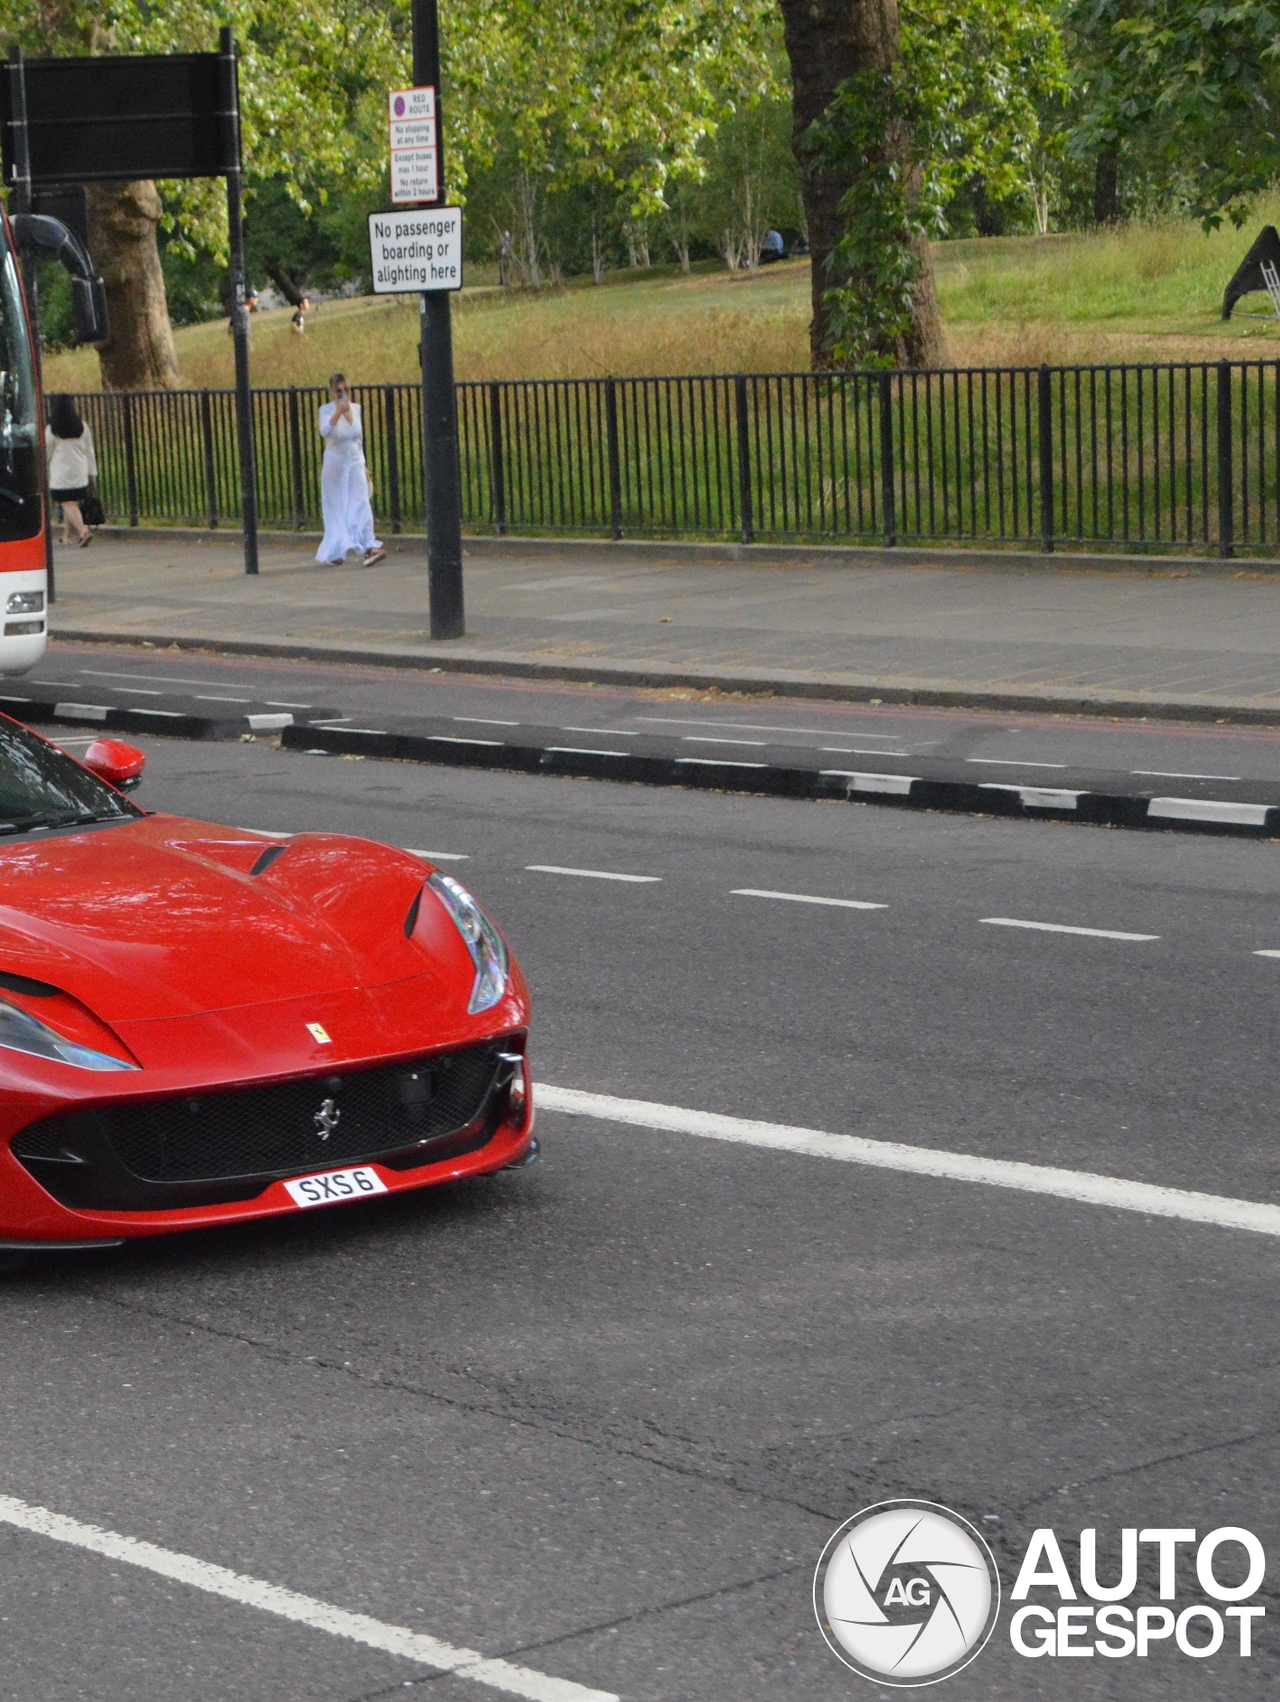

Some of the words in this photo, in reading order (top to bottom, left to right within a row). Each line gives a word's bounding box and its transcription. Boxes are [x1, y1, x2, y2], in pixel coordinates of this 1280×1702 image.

[413, 94, 426, 103] RED
[409, 103, 430, 114] ROUTE
[395, 125, 404, 134] No
[405, 123, 430, 134] stopping
[397, 136, 403, 144] at
[404, 136, 414, 145] any
[416, 134, 429, 143] time
[395, 153, 414, 162] Except
[415, 152, 432, 161] buses
[416, 164, 429, 172] hour
[400, 178, 409, 186] No
[410, 177, 428, 186] return
[395, 188, 411, 197] within
[418, 187, 435, 195] hours
[375, 222, 391, 238] No
[395, 221, 456, 240] passenger
[382, 242, 433, 260] boarding
[437, 243, 449, 256] or
[377, 264, 426, 285] alighting
[430, 263, 457, 279] here
[299, 1174, 354, 1201] SXS
[353, 1171, 374, 1191] 6
